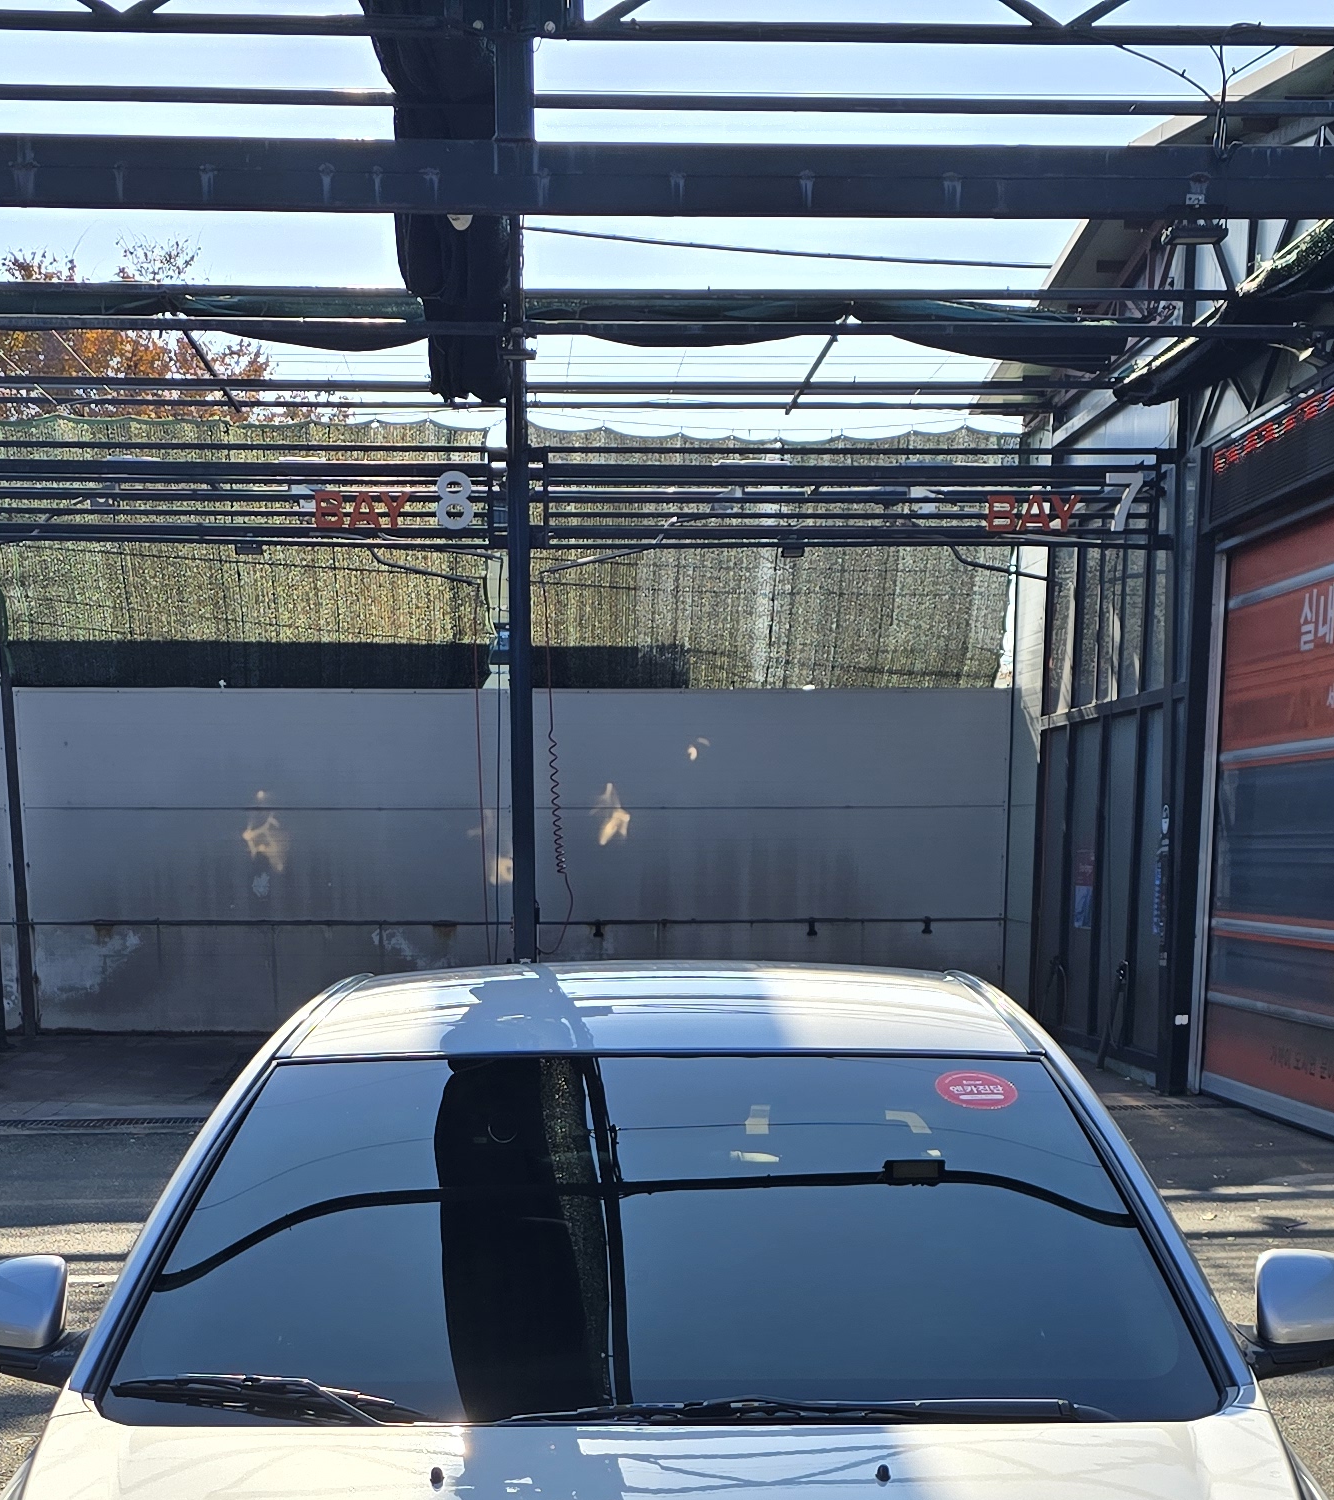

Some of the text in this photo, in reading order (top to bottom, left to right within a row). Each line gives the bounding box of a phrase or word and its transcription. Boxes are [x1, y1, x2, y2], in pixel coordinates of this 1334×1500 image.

[314, 470, 474, 530] BAY 8
[987, 472, 1144, 532] BAY 7
[949, 1084, 1004, 1094] 엔카진단
